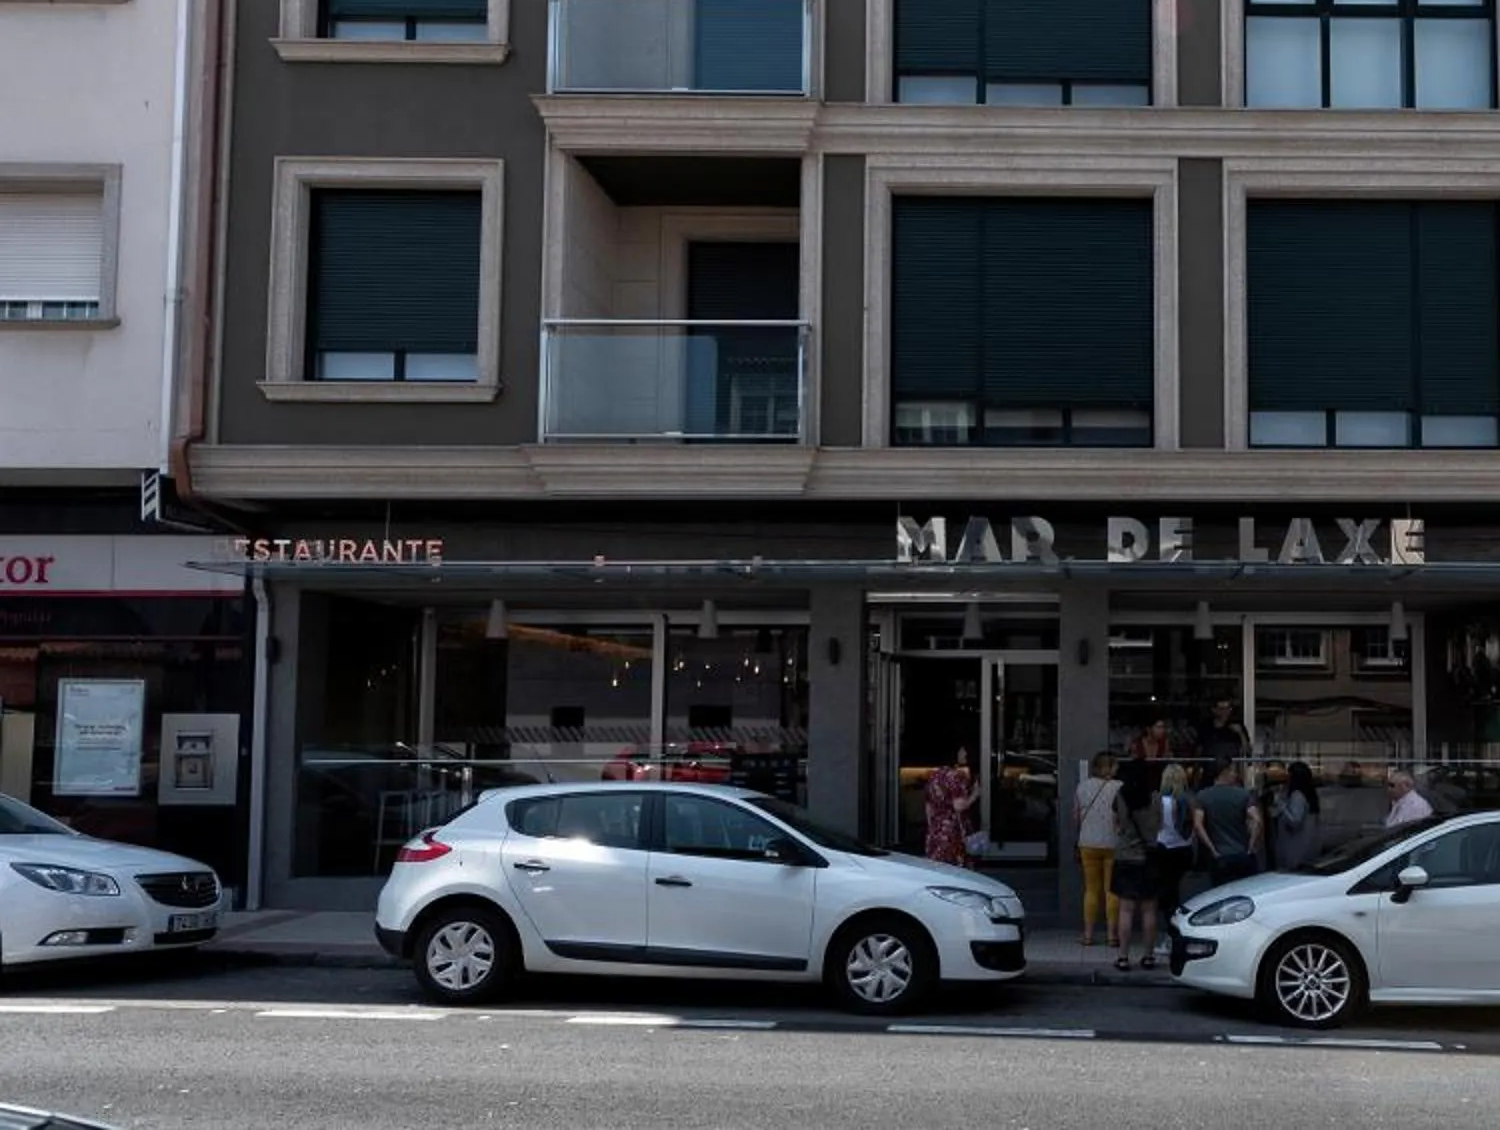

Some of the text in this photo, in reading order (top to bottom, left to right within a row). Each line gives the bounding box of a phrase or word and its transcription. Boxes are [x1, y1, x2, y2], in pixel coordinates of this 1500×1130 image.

[897, 516, 1425, 565] MAR DE LAXE
[0, 555, 55, 584] or
